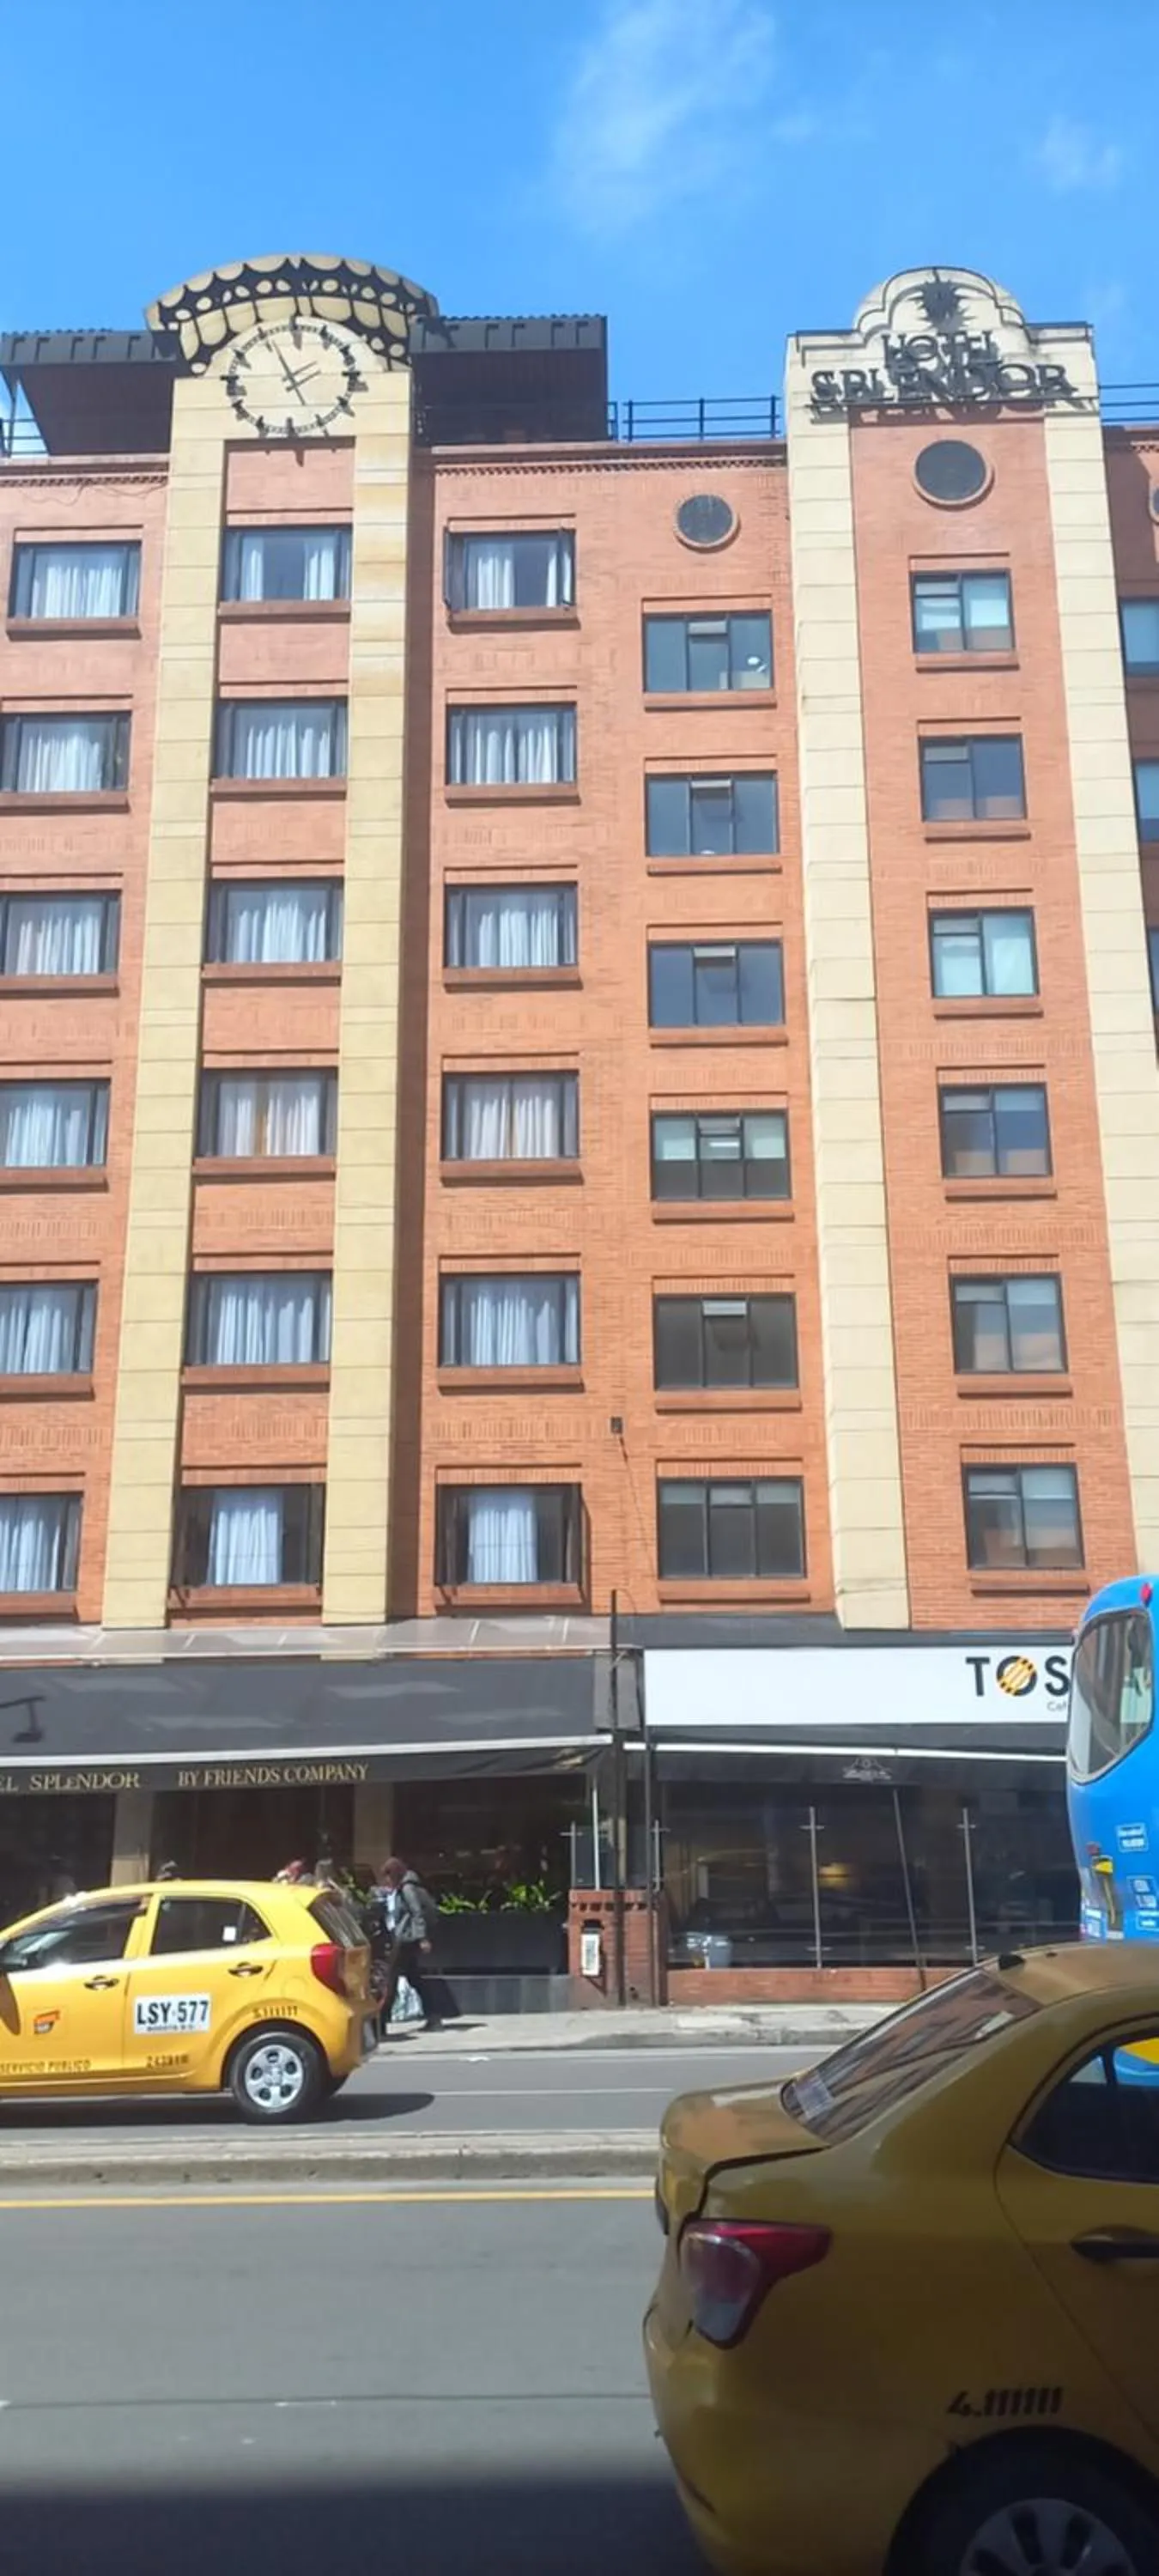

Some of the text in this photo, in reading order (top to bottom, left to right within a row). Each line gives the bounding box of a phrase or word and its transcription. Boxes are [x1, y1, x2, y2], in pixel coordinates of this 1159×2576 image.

[811, 362, 1078, 402] SPLENDOR
[178, 1770, 199, 1787] BY
[204, 1765, 280, 1787] FRIENDS
[283, 1763, 369, 1783] COMPANY
[945, 2386, 1064, 2417] 4.111111
